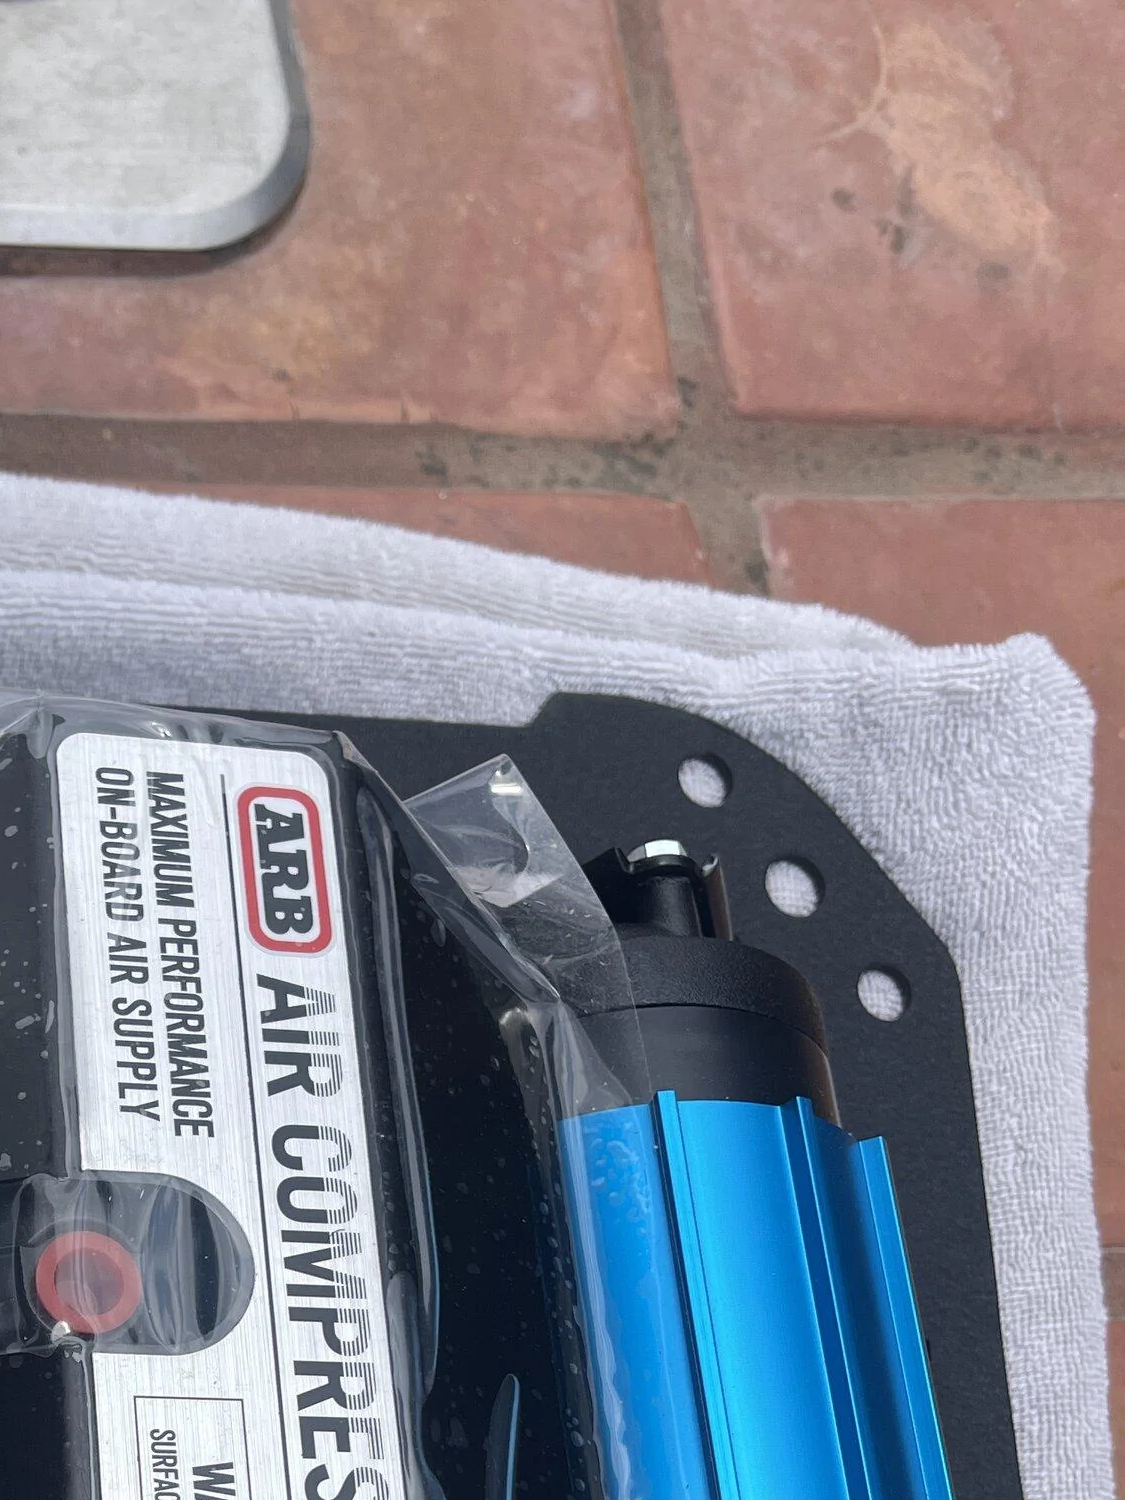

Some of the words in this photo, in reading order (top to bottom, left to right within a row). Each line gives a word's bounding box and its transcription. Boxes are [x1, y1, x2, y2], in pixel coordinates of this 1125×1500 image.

[95, 766, 144, 922] ON-BOARD
[146, 771, 194, 908] MAXIMUM
[254, 803, 315, 935] ARB
[107, 932, 150, 985] AIR
[112, 997, 160, 1122] SUPPLY
[158, 917, 214, 1138] PERFORMANCE
[256, 973, 344, 1097] AIR
